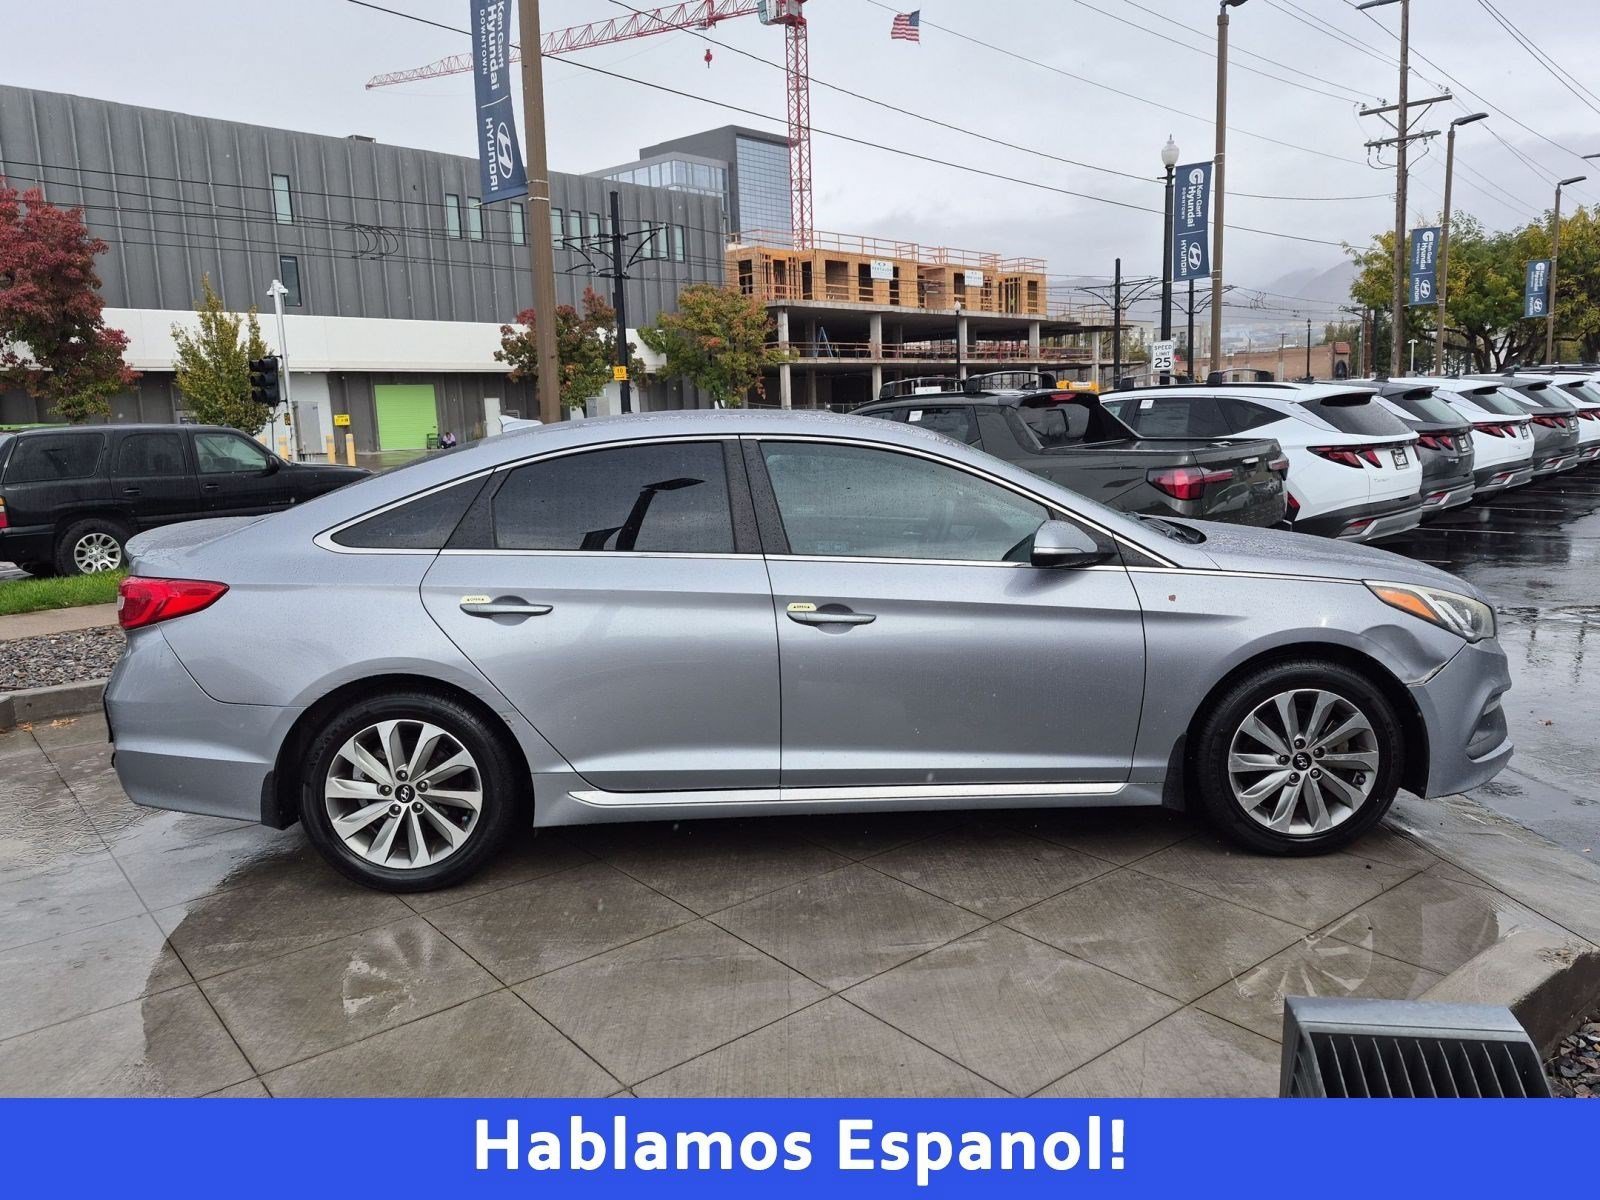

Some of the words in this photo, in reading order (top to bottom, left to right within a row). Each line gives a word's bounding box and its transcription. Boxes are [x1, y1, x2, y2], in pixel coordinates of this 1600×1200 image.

[487, 4, 499, 90] Hyundai
[486, 117, 498, 191] HYUNDAI
[1187, 186, 1196, 227] Hyundai
[1196, 185, 1204, 200] Ken
[1154, 357, 1171, 368] 25
